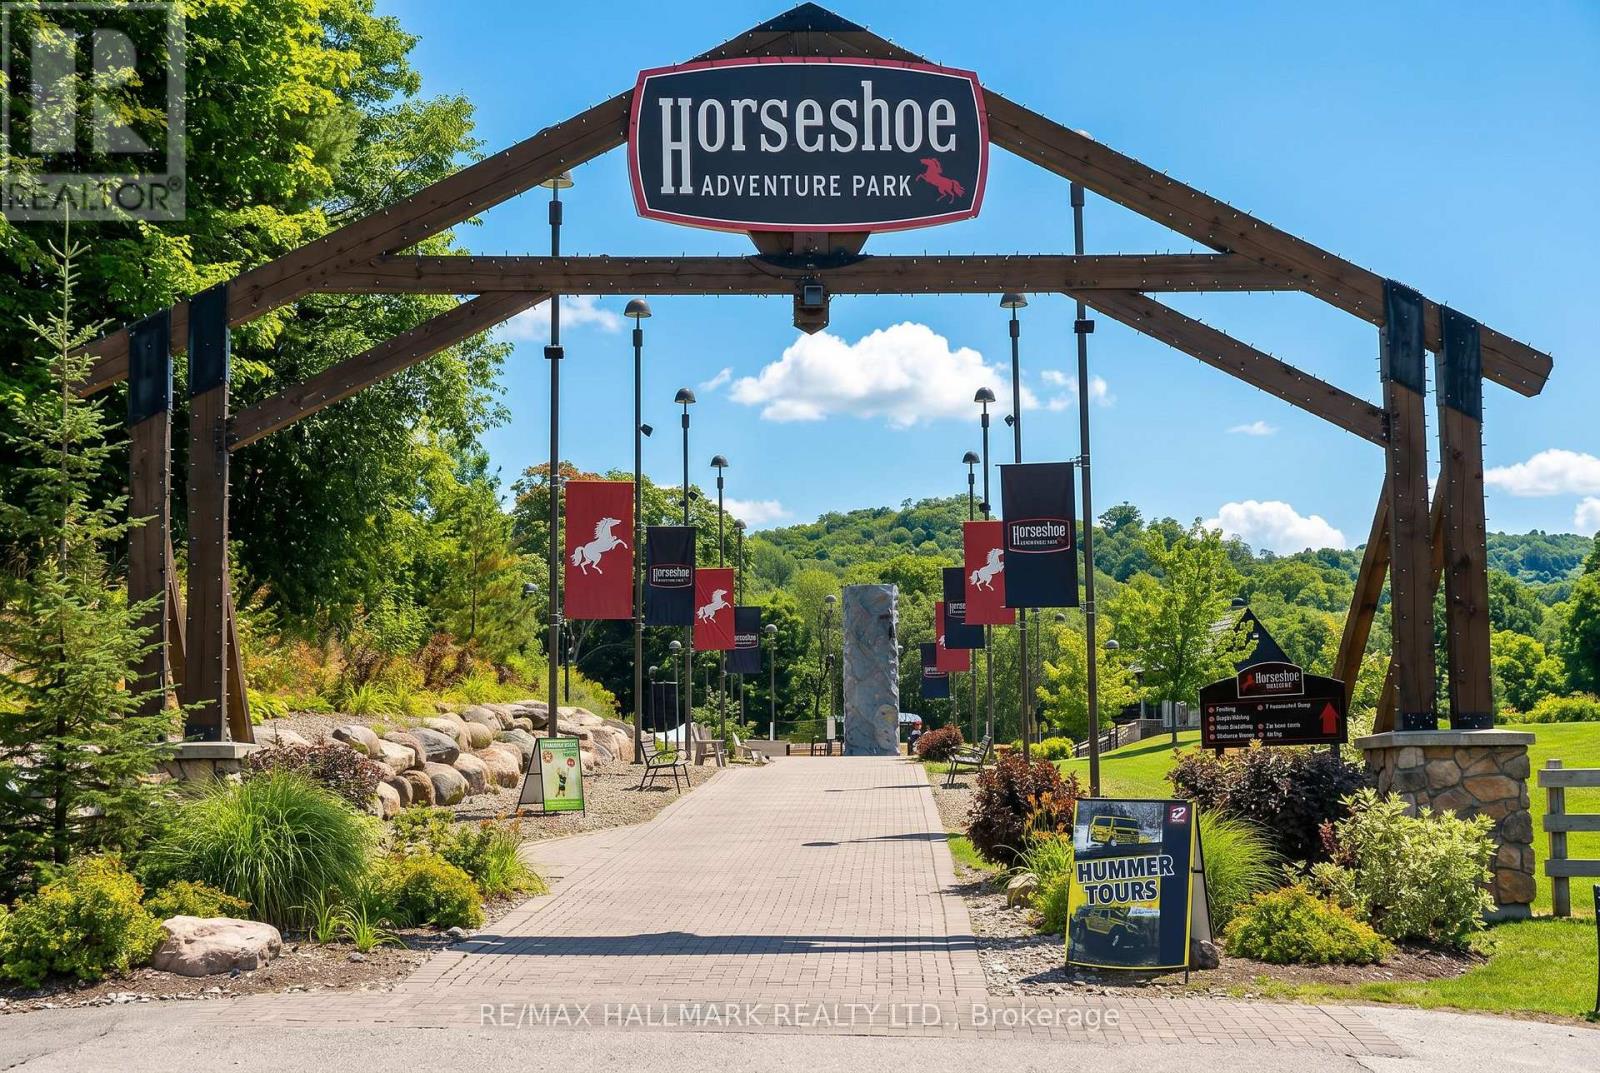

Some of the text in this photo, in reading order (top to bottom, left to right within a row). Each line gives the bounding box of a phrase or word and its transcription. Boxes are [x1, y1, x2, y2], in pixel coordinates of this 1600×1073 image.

[659, 80, 956, 195] Horseshoe
[701, 174, 913, 197] ADVENTURE PARK
[1012, 521, 1066, 545] Horseshoe
[1255, 669, 1299, 684] Horseshoe
[1077, 855, 1175, 883] HUMMER
[1085, 880, 1158, 906] TOURS
